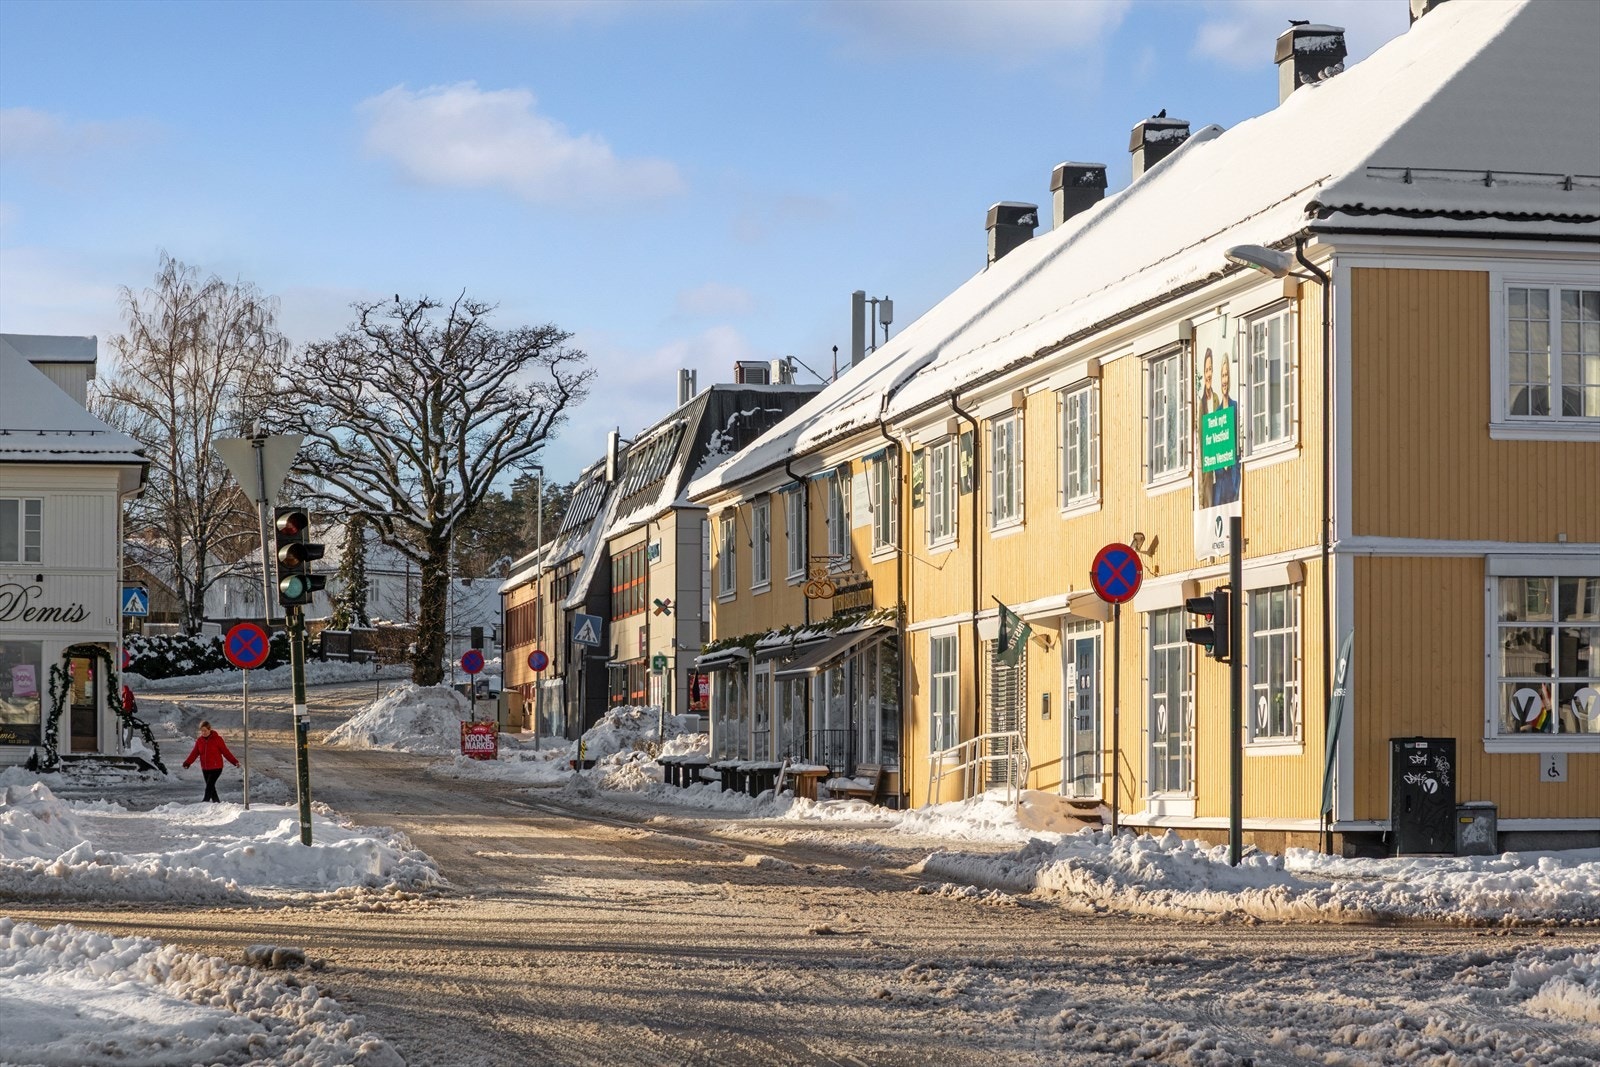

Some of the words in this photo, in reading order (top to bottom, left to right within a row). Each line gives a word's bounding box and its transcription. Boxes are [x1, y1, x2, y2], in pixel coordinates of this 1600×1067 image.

[1212, 428, 1229, 444] Vestfold
[0, 583, 91, 623] Demis
[376, 664, 382, 673] P
[465, 734, 494, 742] KRONE-
[465, 742, 495, 750] MARKED
